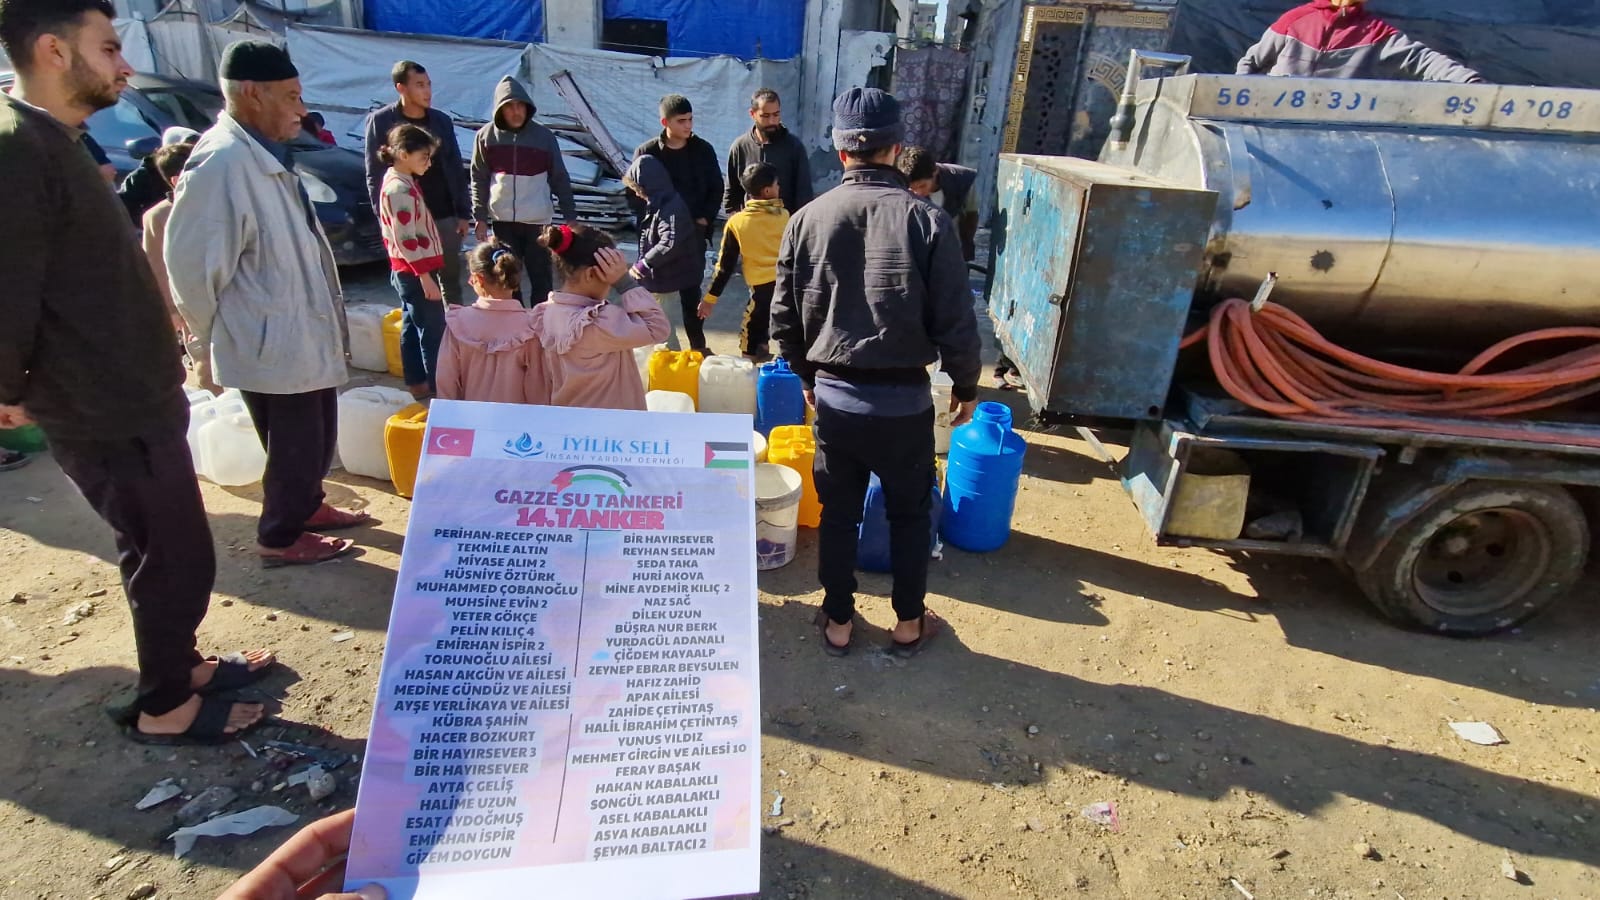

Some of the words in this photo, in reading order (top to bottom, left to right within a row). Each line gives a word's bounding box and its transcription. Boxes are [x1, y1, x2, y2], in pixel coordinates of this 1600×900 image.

[1217, 88, 1250, 106] 56
[563, 435, 623, 453] İYİLİK
[630, 439, 670, 455] SELİ
[591, 454, 632, 463] YARDIM
[495, 490, 558, 506] GAZZE
[563, 493, 590, 507] SU
[594, 492, 683, 510] TANKERİ
[516, 507, 665, 530] 14.TANKER
[434, 528, 533, 541] PERİHAN-RECEP
[536, 533, 573, 545] ÇINAR
[624, 533, 643, 543] BİR
[645, 535, 714, 544] HAYIRSEVER
[457, 542, 510, 553] TEKMİLE
[513, 545, 548, 555] ALTIN
[623, 548, 669, 556] REYHAN
[670, 547, 716, 555] SELMAN
[458, 554, 505, 567] MİYASE
[507, 558, 537, 568] ALIM
[539, 560, 546, 568] 2
[637, 560, 666, 568] SEDA
[669, 560, 699, 568] TAKA
[444, 567, 501, 580] HÜSNİYE
[504, 570, 555, 582] ÖZTÜRK
[632, 570, 662, 581] HURİ
[664, 572, 704, 580] AKOVA
[416, 582, 497, 594] MUHAMMED
[500, 583, 578, 596] ÇOBANOĞLU
[605, 582, 635, 593] MİNE
[637, 582, 689, 593] AYDEMİR
[691, 584, 720, 595] KILIÇ
[724, 584, 730, 592] 2
[445, 595, 506, 607] MUHSİNE
[509, 596, 539, 608] EVİN
[541, 600, 548, 609] 2
[644, 598, 667, 607] NAZ
[669, 594, 691, 606] SAĞ
[453, 611, 492, 622] YETER
[495, 610, 537, 624] GÖKÇE
[632, 608, 667, 620] DİLEK
[669, 610, 702, 619] UZUN
[450, 623, 489, 636] PELİN
[491, 627, 525, 639] KILIÇ
[526, 628, 535, 637] 4
[615, 622, 656, 634] BÜŞRA
[658, 623, 683, 632] NUR
[686, 623, 717, 632] BERK
[436, 637, 500, 650] EMİRHAN
[502, 638, 535, 651] İSPİR
[538, 642, 545, 651] 2
[606, 635, 671, 647] YURDAGÜL
[673, 635, 725, 645] ADANALI
[424, 652, 510, 665] TORUNOĞLU
[512, 653, 552, 665] AİLESİ
[614, 648, 659, 663] ÇİĞDEM
[662, 649, 716, 659] KAYAALP
[404, 670, 453, 680] HASAN
[455, 667, 505, 680] AKGÜN
[508, 670, 527, 680] VE
[528, 667, 566, 680] AİLESİ
[588, 666, 634, 675] ZEYNEP
[636, 664, 676, 674] EBRAR
[678, 661, 739, 672] BEYSULEN
[626, 678, 662, 688] HAFIZ
[664, 675, 701, 687] ZAHİD
[394, 682, 451, 695] MEDİNE
[452, 682, 510, 696] GÜNDÜZ
[512, 685, 529, 695] VE
[531, 682, 572, 695] AİLESİ
[626, 692, 660, 702] APAK
[662, 688, 700, 701] AİLESİ
[394, 701, 429, 714] AYŞE
[432, 698, 507, 711] YERLİKAYA
[511, 700, 528, 710] VE
[529, 697, 570, 710] AİLESİ
[608, 704, 655, 718] ZAHİDE
[656, 702, 714, 717] ÇETİNTAŞ
[432, 714, 482, 727] KÜBRA
[485, 713, 528, 729] ŞAHİN
[585, 720, 620, 733] HALİL
[623, 718, 678, 731] İBRAHİM
[680, 715, 738, 730] ÇETİNTAŞ
[420, 733, 468, 743] HACER
[470, 731, 535, 742] BOZKURT
[618, 735, 662, 747] YUNUS
[664, 733, 703, 743] YILDIZ
[413, 747, 440, 760] BİR
[442, 748, 528, 759] HAYIRSEVER
[529, 748, 536, 757] 3
[572, 752, 627, 765] MEHMET
[628, 748, 671, 761] GİRGİN
[674, 748, 689, 757] VE
[691, 742, 731, 756] AİLESİ
[733, 744, 747, 754] 10
[414, 763, 440, 776] BİR
[443, 763, 529, 776] HAYIRSEVER
[616, 765, 655, 777] FERAY
[658, 762, 701, 775] BAŞAK
[428, 781, 474, 795] AYTAÇ
[476, 777, 514, 794] GELİŞ
[596, 781, 642, 794] HAKAN
[645, 775, 718, 790] KABALAKLI
[420, 795, 475, 811] HALİME
[477, 797, 517, 809] UZUN
[590, 794, 643, 810] SONGÜL
[646, 790, 720, 805] KABALAKLI
[406, 817, 442, 829] ESAT
[444, 810, 524, 827] AYDOĞMUŞ
[599, 813, 630, 825] ASEL
[633, 807, 708, 822] KABALAKLI
[409, 831, 477, 846] EMİRHAN
[479, 828, 515, 843] İSPİR
[594, 829, 628, 842] ASYA
[631, 822, 707, 838] KABALAKLI
[406, 850, 449, 865] GİZEM
[452, 847, 512, 862] DOYGUN
[594, 844, 638, 861] ŞEYMA
[641, 840, 697, 854] BALTACI
[699, 839, 707, 848] 2
